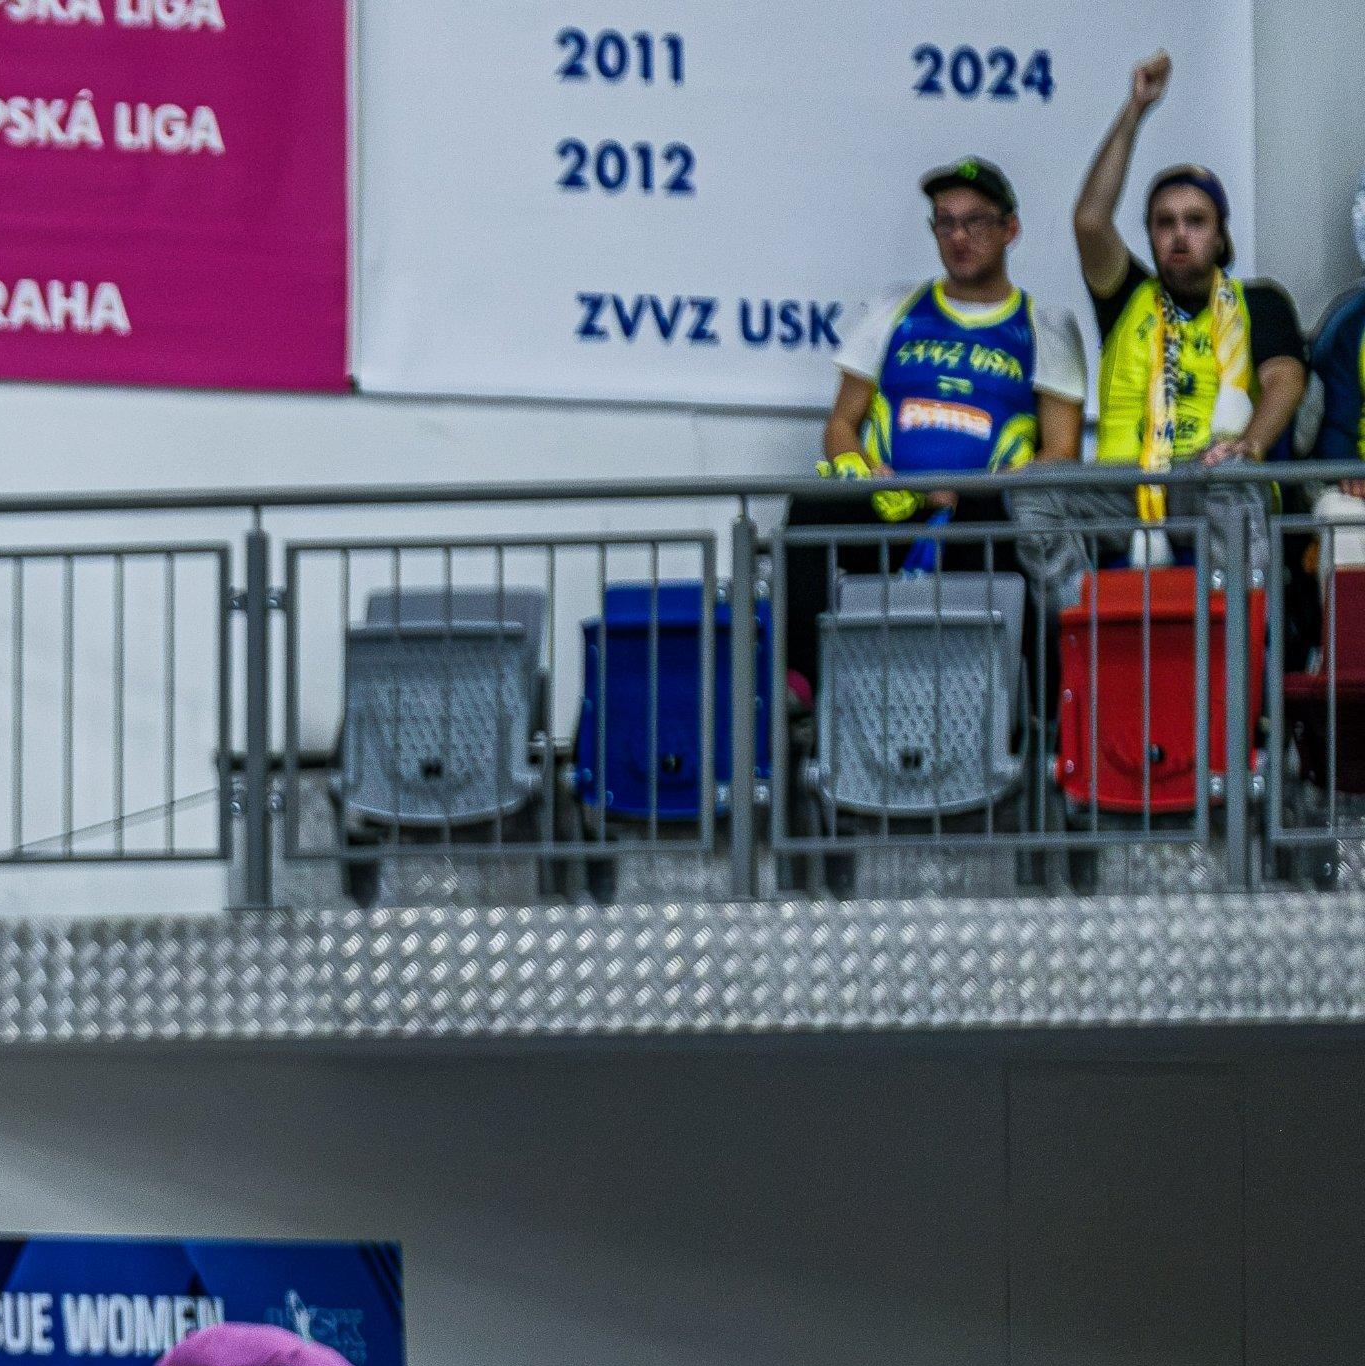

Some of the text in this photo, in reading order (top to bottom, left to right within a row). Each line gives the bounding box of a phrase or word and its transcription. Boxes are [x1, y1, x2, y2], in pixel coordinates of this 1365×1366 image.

[556, 27, 1055, 102] 2011 2024
[114, 102, 226, 155] LIGA
[556, 137, 697, 195] 2012
[576, 291, 844, 350] ZVVZ USK
